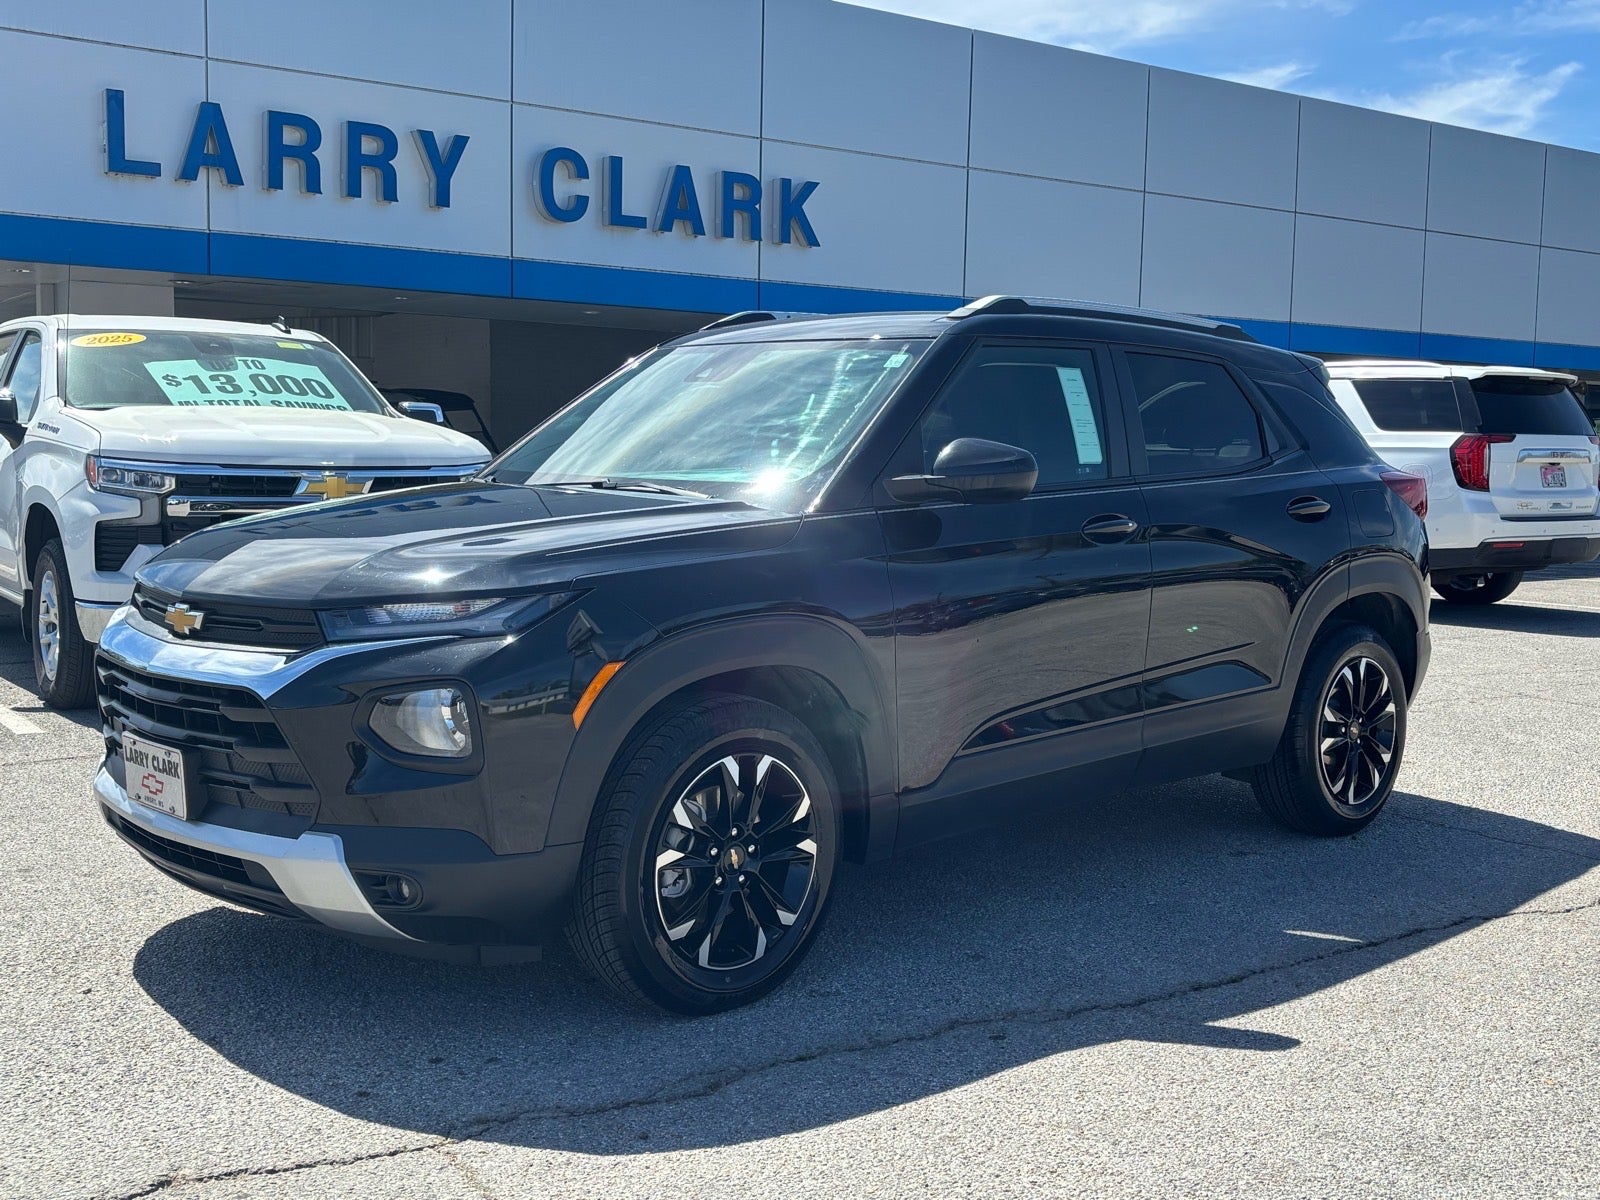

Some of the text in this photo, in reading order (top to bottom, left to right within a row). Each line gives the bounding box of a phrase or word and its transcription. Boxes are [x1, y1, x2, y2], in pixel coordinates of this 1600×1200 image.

[102, 88, 821, 248] LARRY CLARK
[86, 335, 133, 345] 2025
[208, 359, 267, 371] UP TO
[161, 374, 335, 399] $13,000
[124, 745, 180, 779] LARRY CLARK
